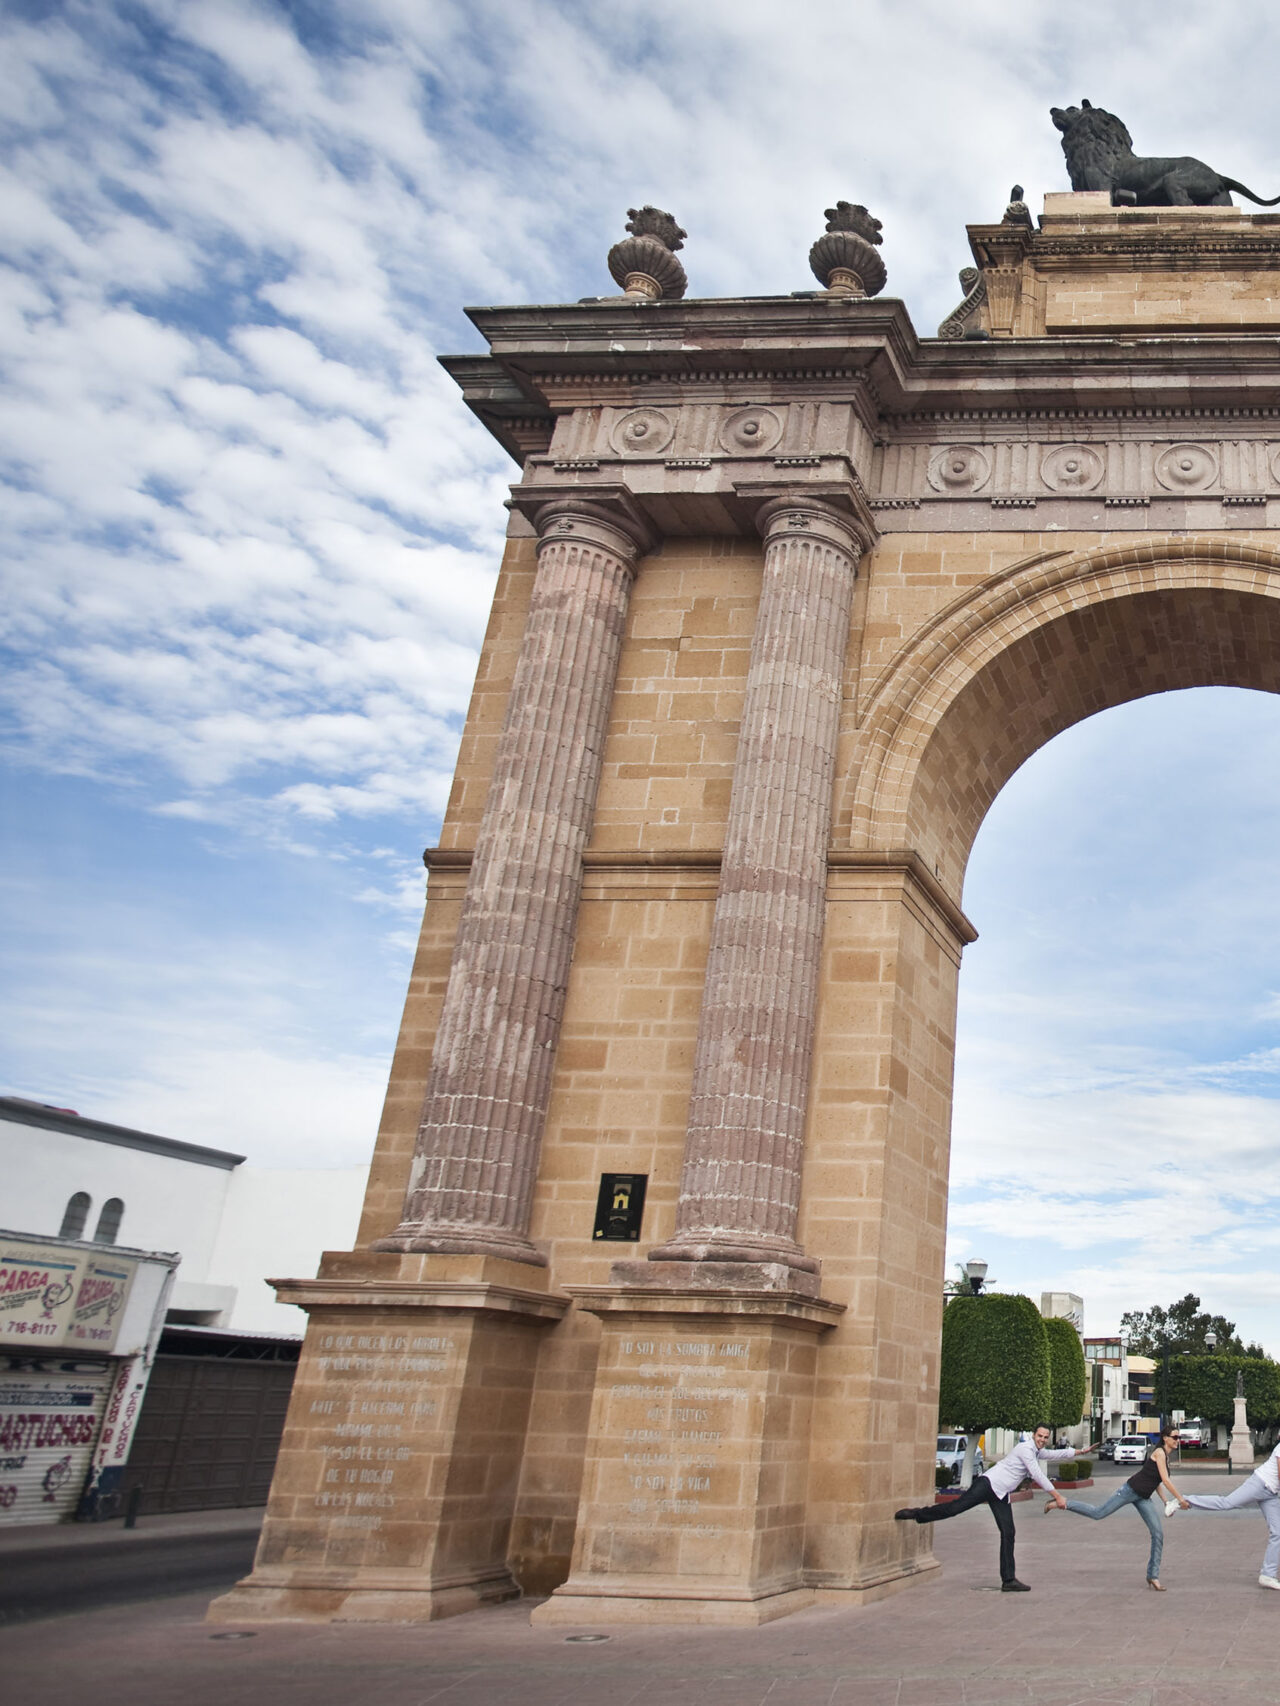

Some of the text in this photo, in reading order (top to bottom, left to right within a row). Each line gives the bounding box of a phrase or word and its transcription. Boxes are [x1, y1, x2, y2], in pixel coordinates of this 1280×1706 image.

[7, 1320, 58, 1336] 716-8117
[636, 1342, 655, 1355] SOY
[0, 1413, 96, 1452] ARTUCHOS
[647, 1475, 666, 1489] SOY
[688, 1476, 712, 1491] VIGA
